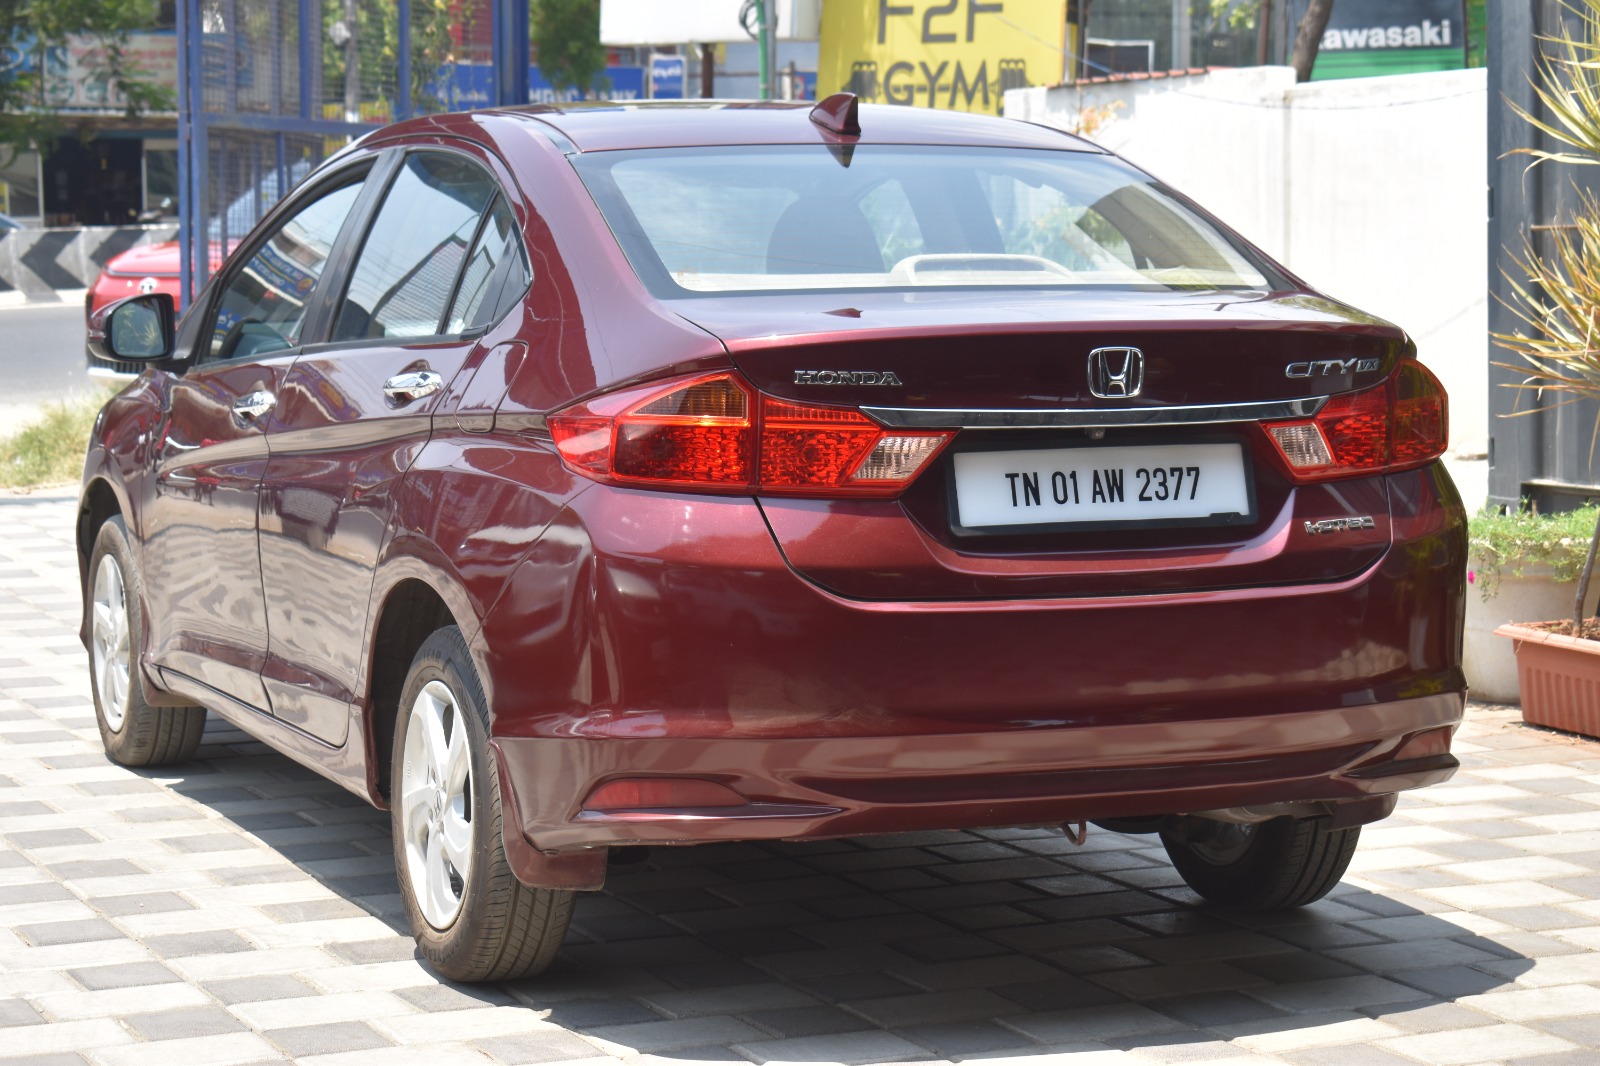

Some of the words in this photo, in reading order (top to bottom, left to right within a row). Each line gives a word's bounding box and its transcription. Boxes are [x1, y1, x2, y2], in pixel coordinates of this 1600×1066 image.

[1319, 19, 1452, 49] awasaki
[883, 59, 990, 110] GYM
[794, 370, 903, 386] HONDA
[1285, 358, 1358, 379] CITY
[1358, 359, 1379, 372] VX
[1005, 471, 1041, 507] TN
[1051, 470, 1080, 505] 01
[1092, 468, 1125, 504] AW
[1135, 466, 1200, 502] 2377
